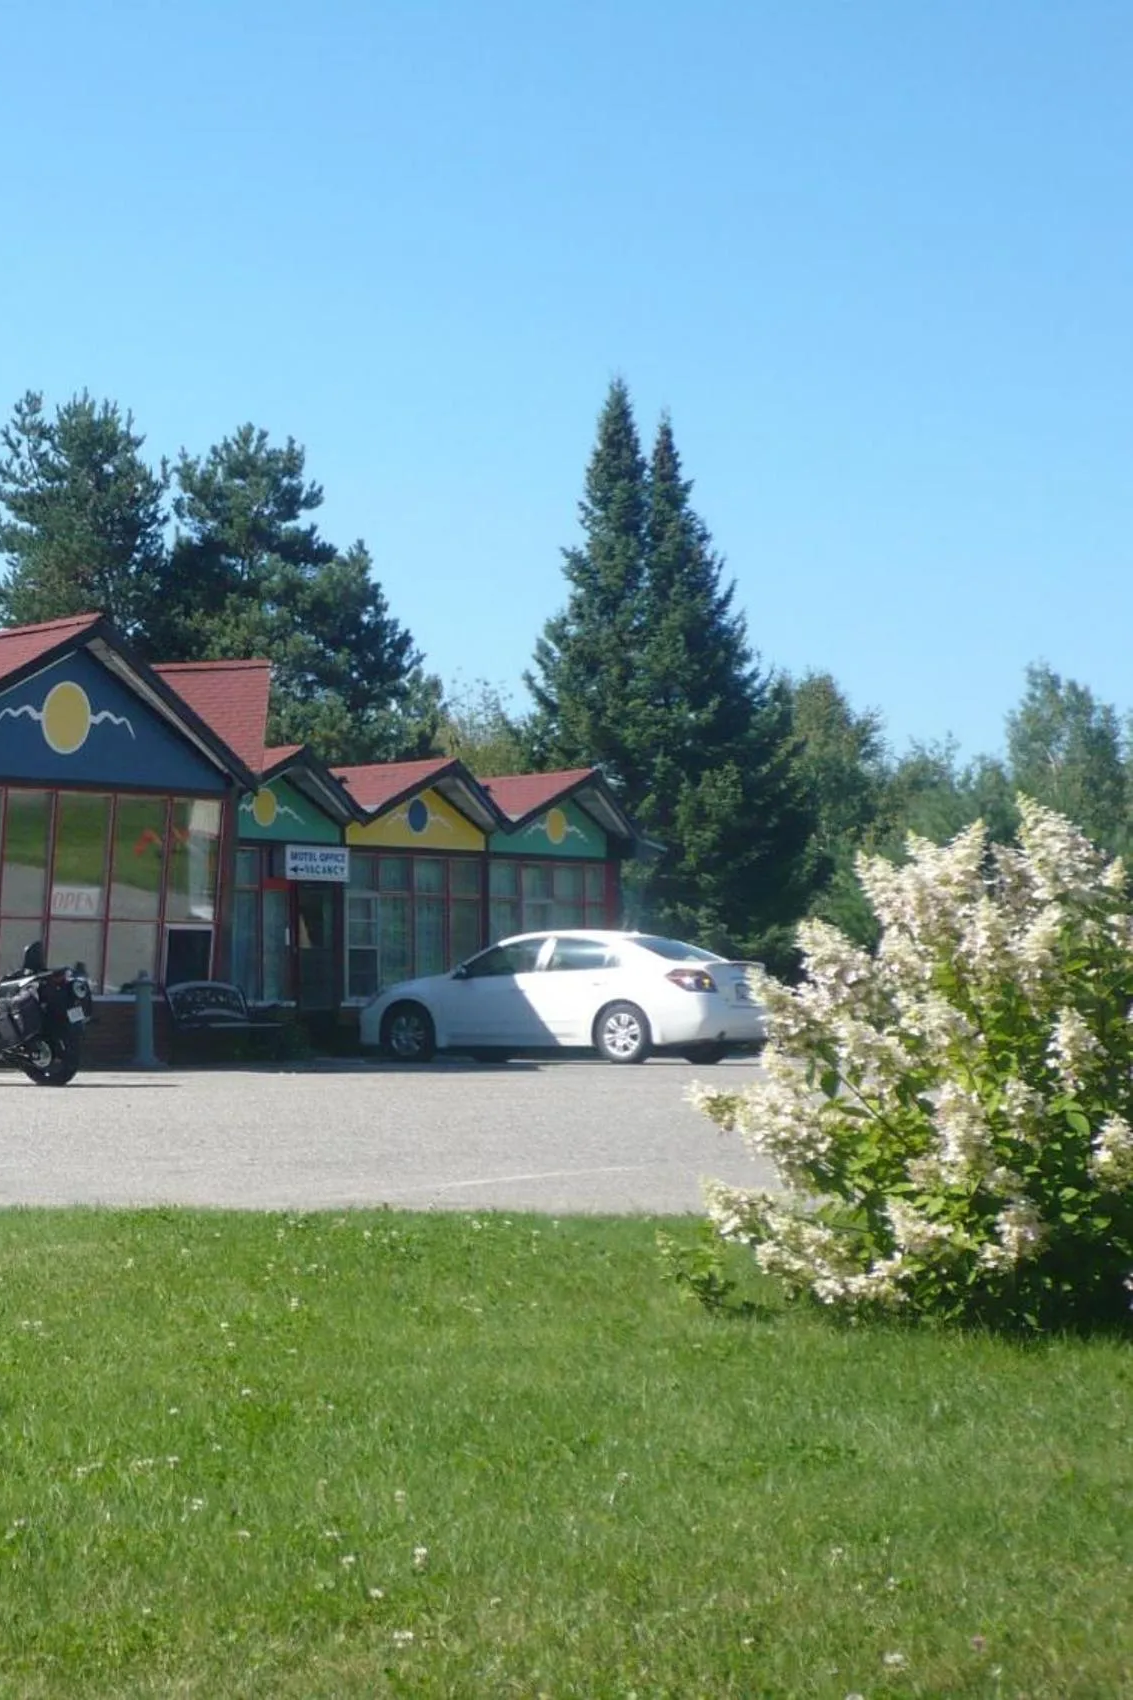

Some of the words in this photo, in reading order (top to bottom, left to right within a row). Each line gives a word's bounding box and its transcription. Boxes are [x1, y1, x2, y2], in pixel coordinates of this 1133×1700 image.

[290, 850, 317, 862] MOTEL
[319, 852, 346, 864] OFFICE
[305, 864, 345, 876] VACANCY
[53, 891, 94, 911] OPEN
